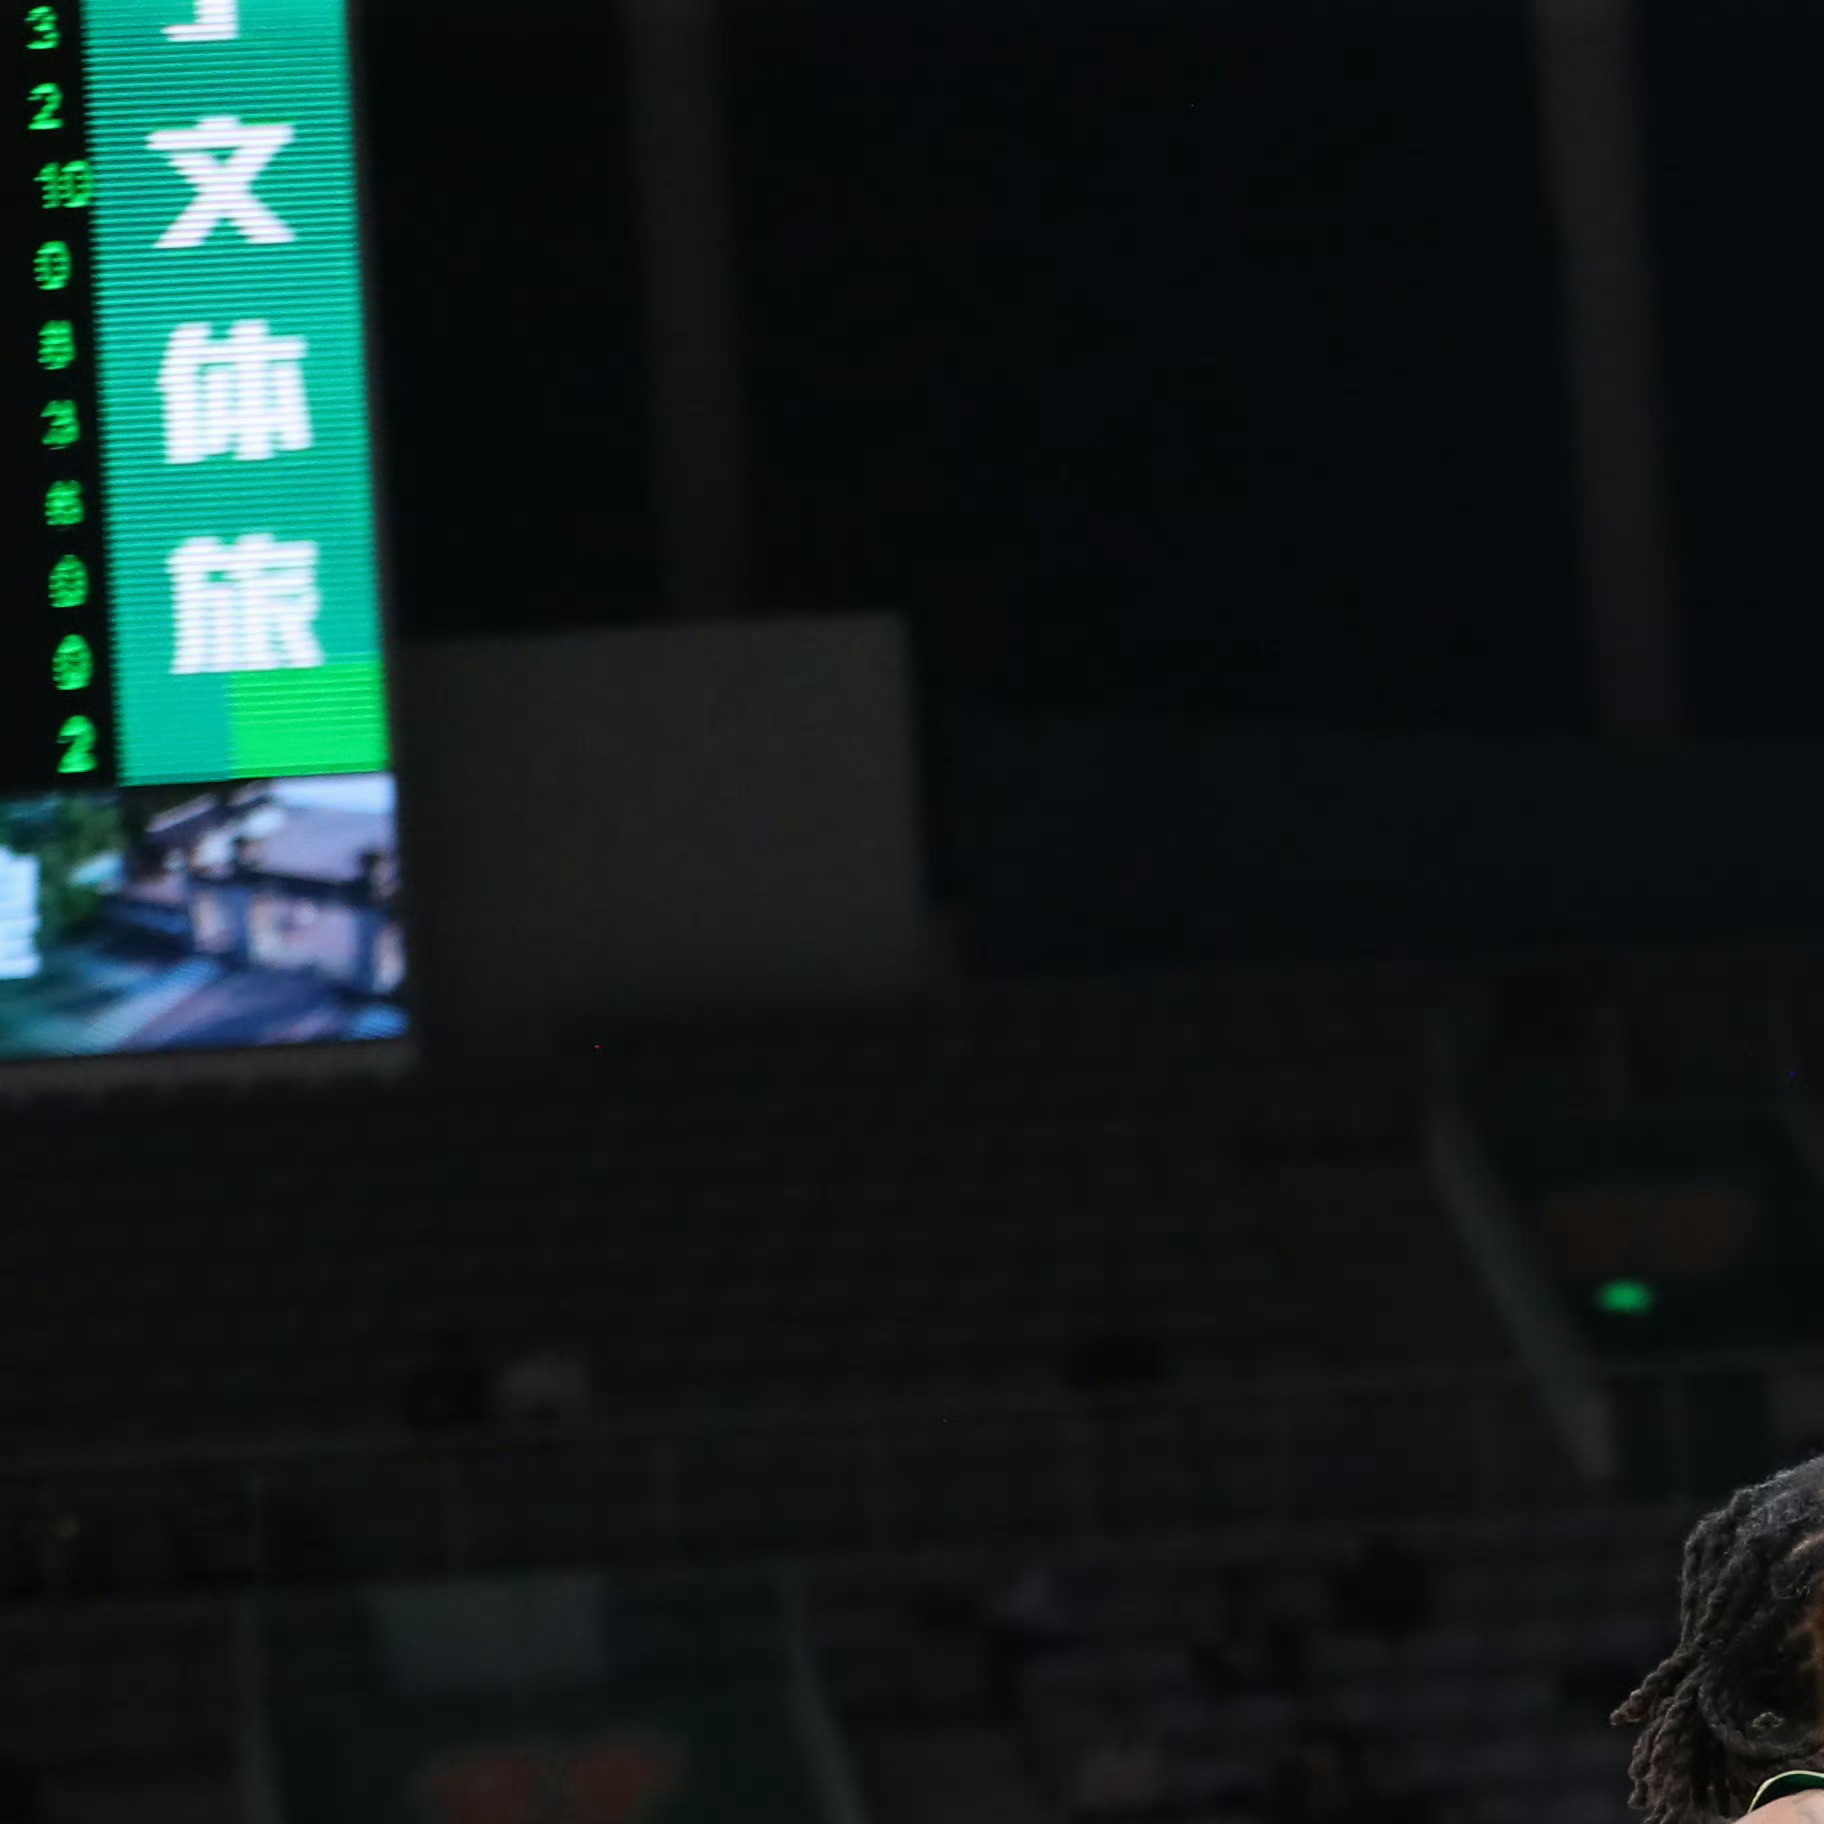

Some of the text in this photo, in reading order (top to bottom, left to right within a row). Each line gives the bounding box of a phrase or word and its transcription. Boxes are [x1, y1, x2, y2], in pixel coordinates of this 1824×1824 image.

[24, 5, 61, 50] 3
[27, 81, 65, 130] 2
[33, 159, 95, 209] 10
[57, 714, 99, 774] 2
